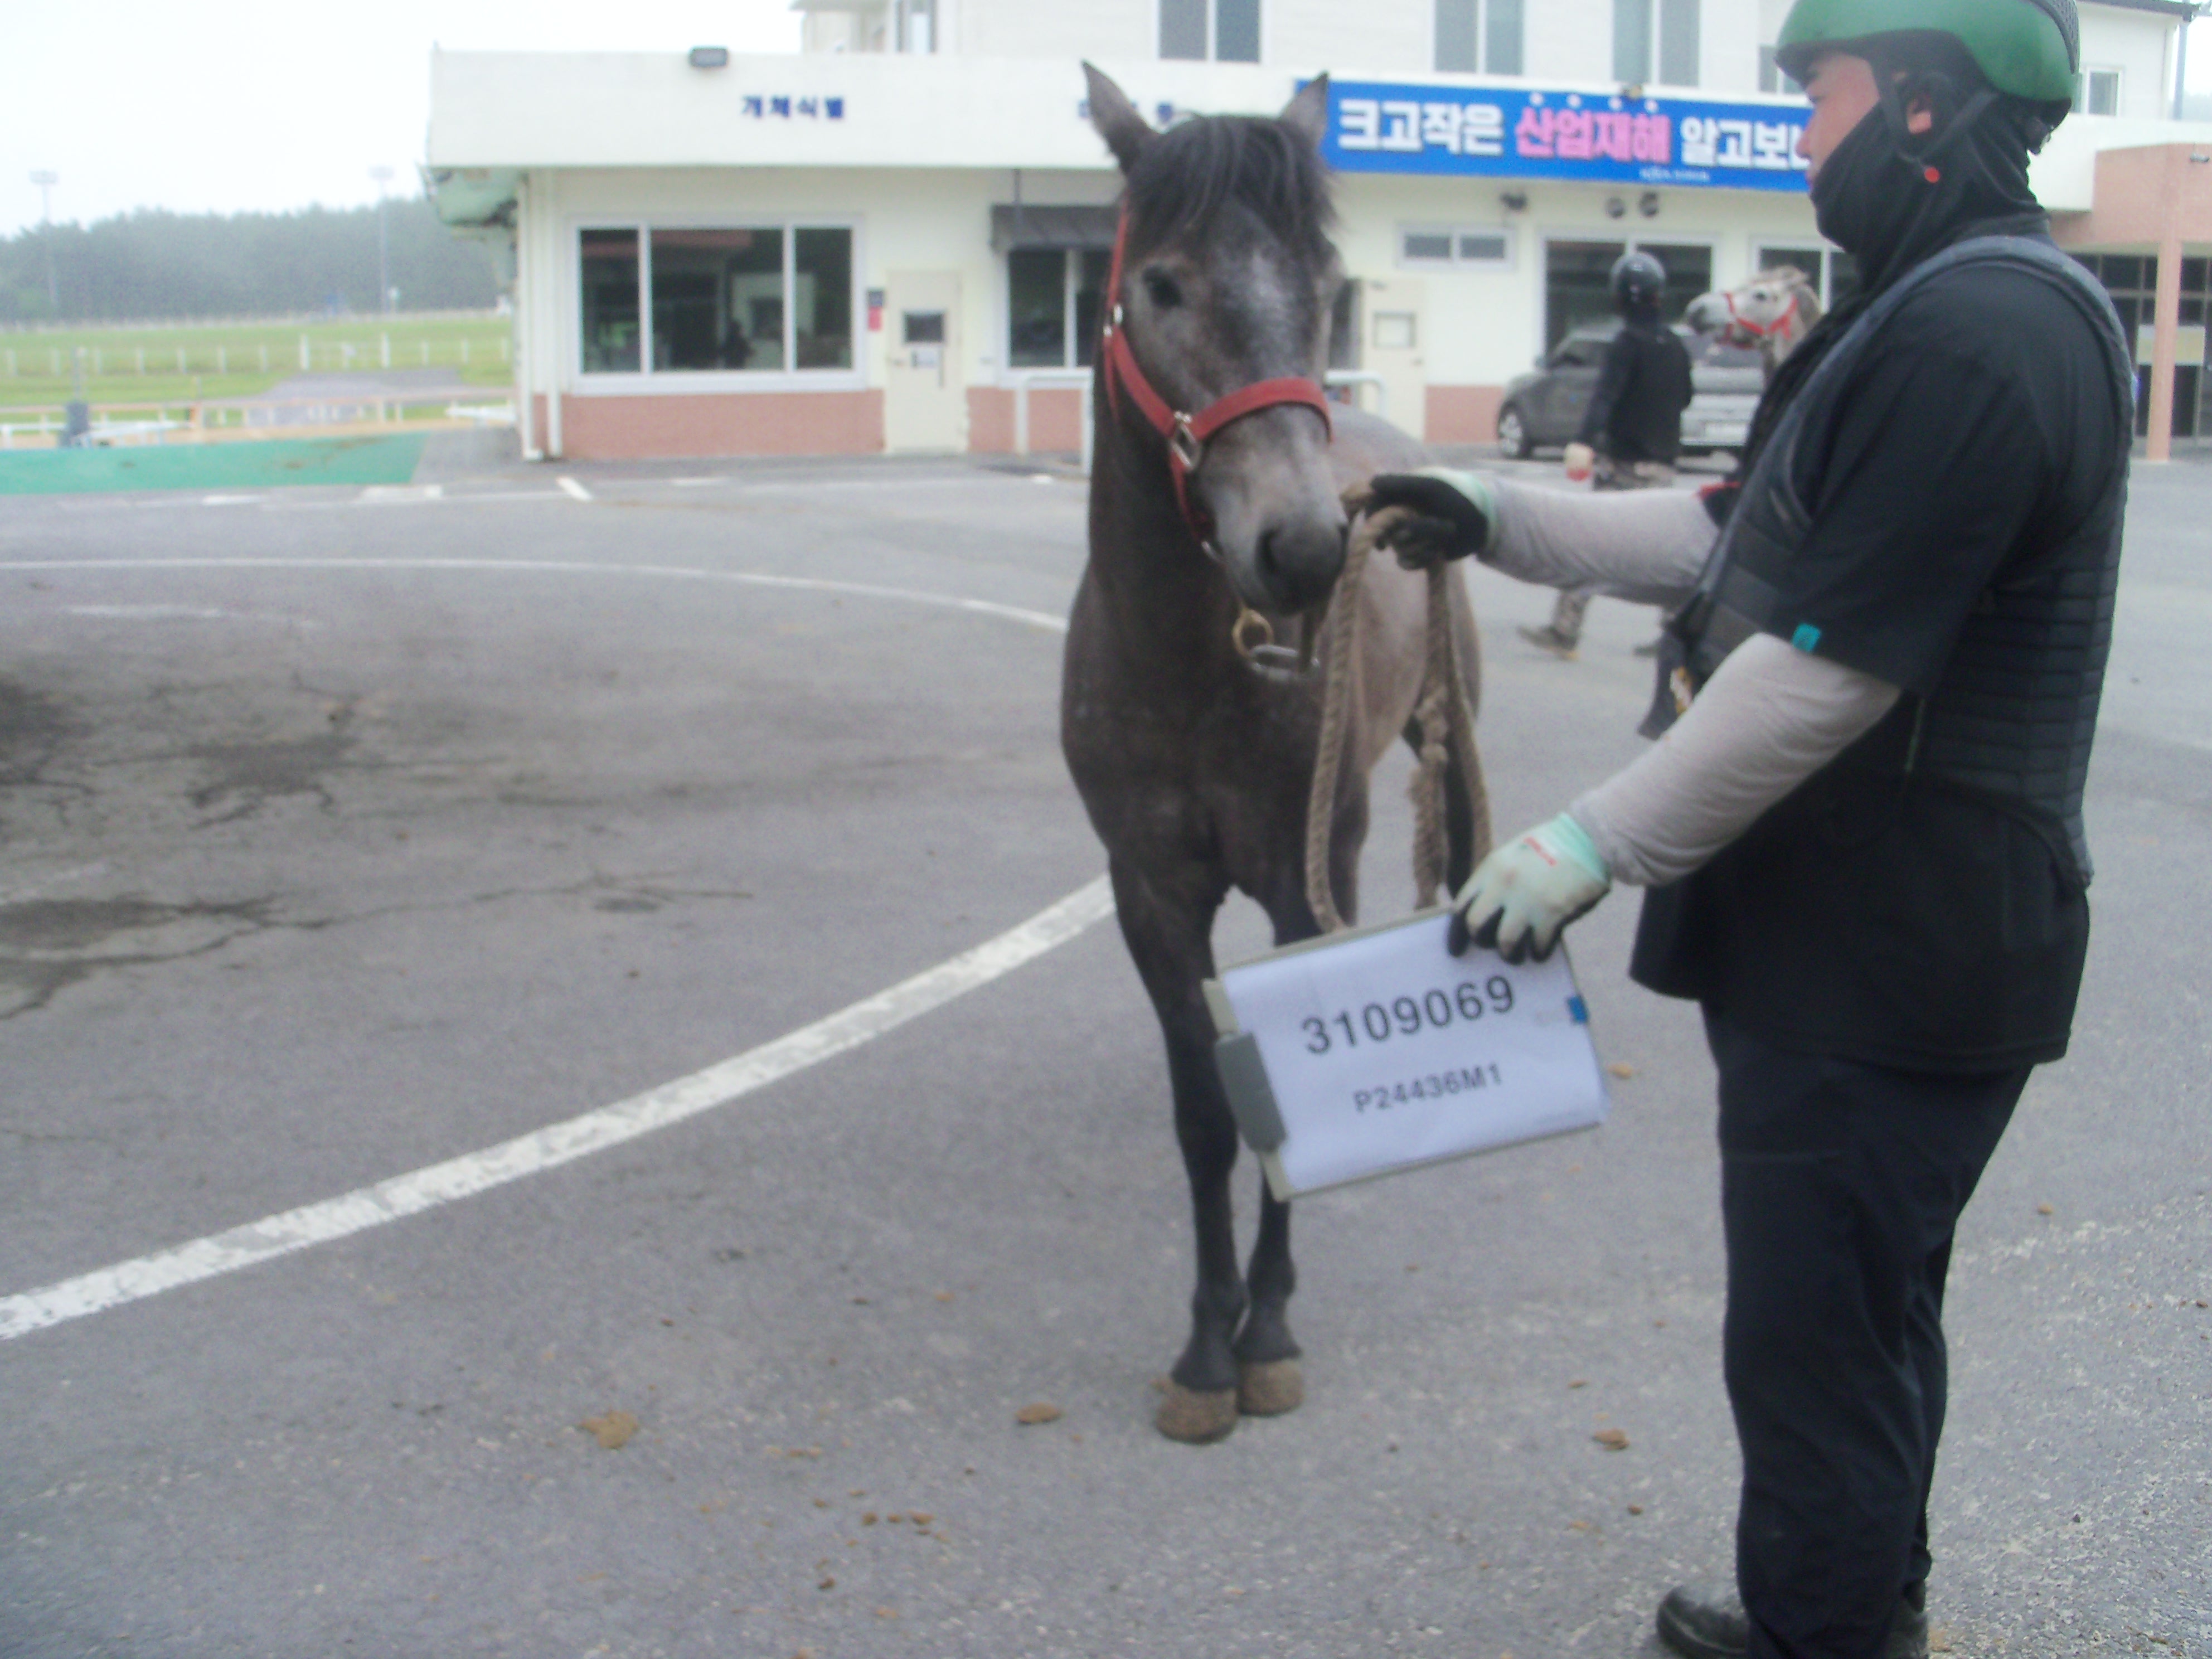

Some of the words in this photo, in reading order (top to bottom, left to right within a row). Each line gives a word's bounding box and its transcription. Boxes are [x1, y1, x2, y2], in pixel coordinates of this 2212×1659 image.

[1339, 99, 1503, 156] 크고작은
[1515, 106, 1670, 163] 산업재해
[1302, 975, 1514, 1054] 3109069
[1354, 1063, 1501, 1112] P24436M1
